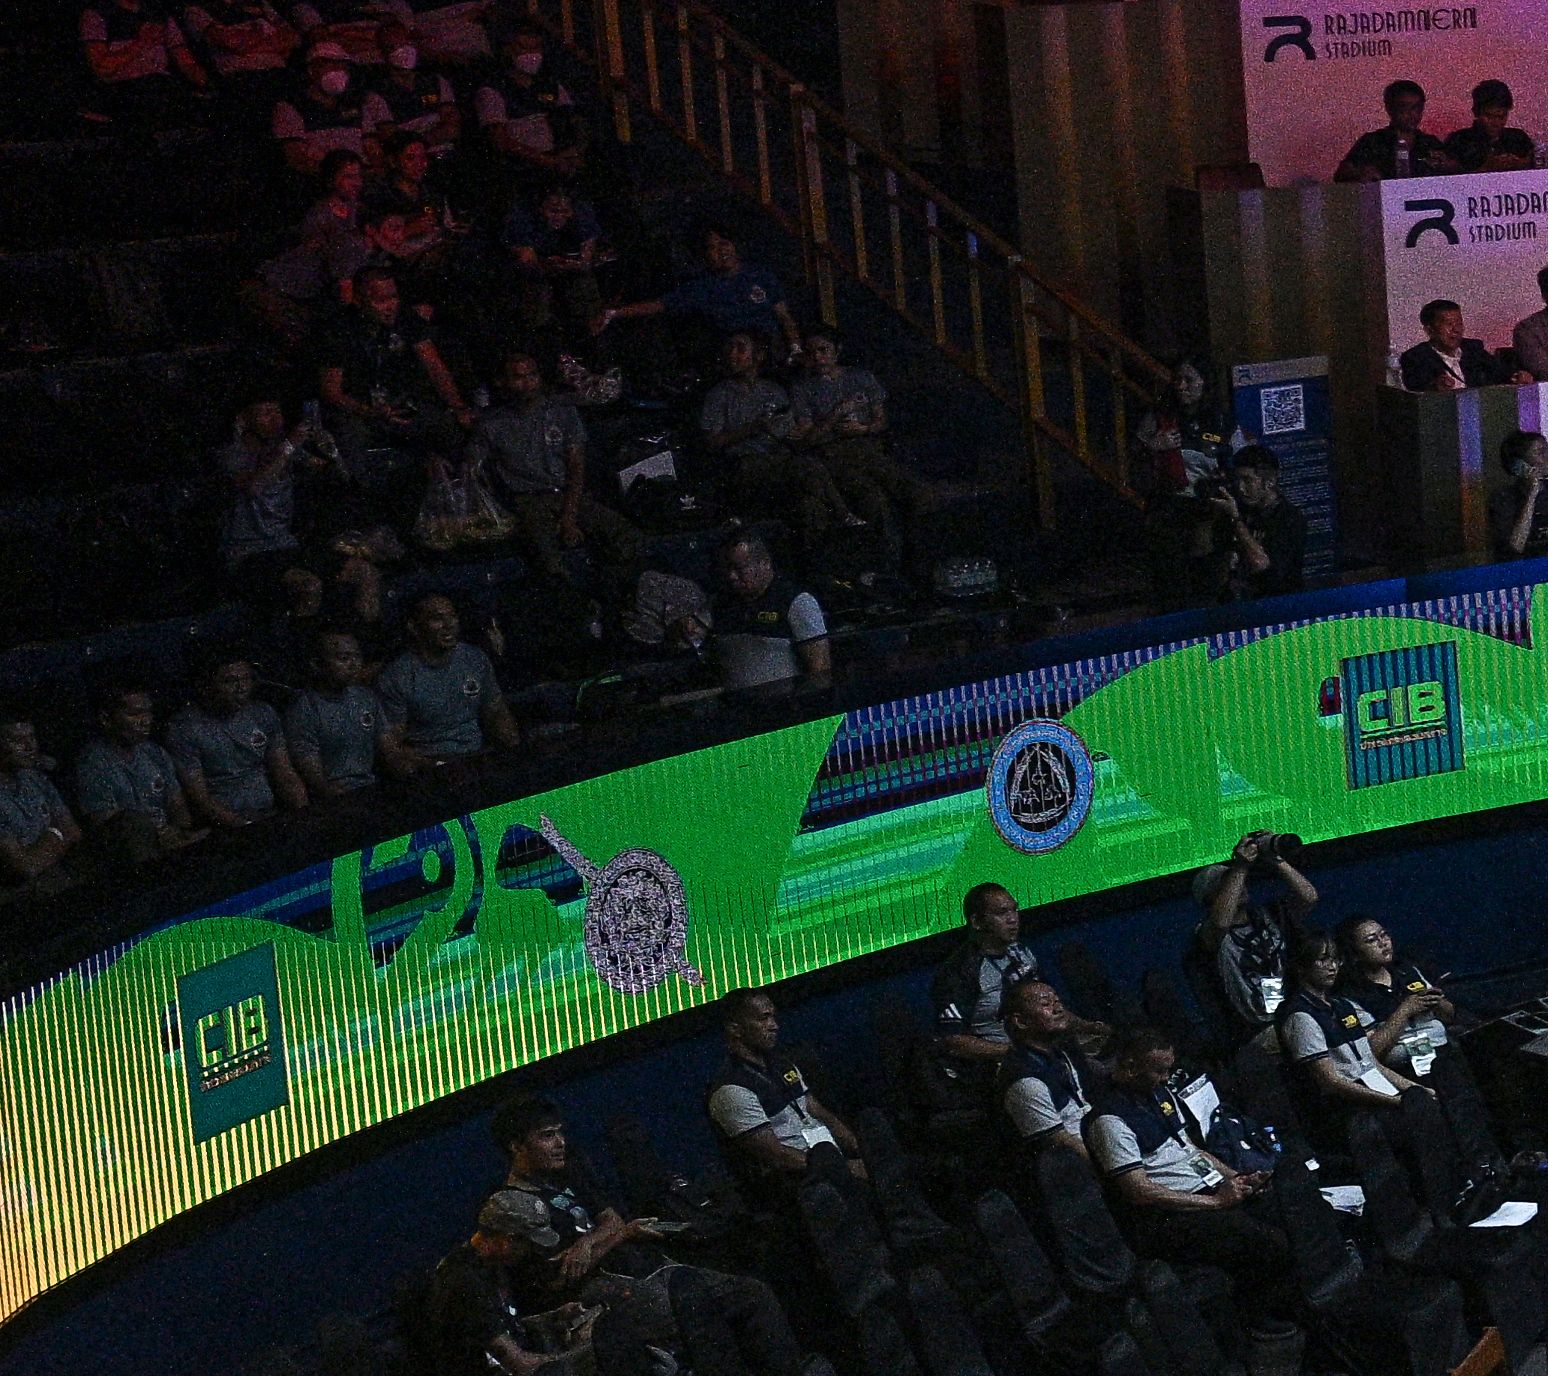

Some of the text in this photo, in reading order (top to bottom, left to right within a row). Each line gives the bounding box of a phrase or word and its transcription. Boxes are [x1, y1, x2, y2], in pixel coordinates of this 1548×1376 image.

[1324, 7, 1478, 35] RAJADAMNERN
[1325, 39, 1393, 59] STADIUM
[1468, 221, 1537, 243] STADIUM
[1357, 681, 1447, 731] CIB
[195, 994, 270, 1068] CIB
